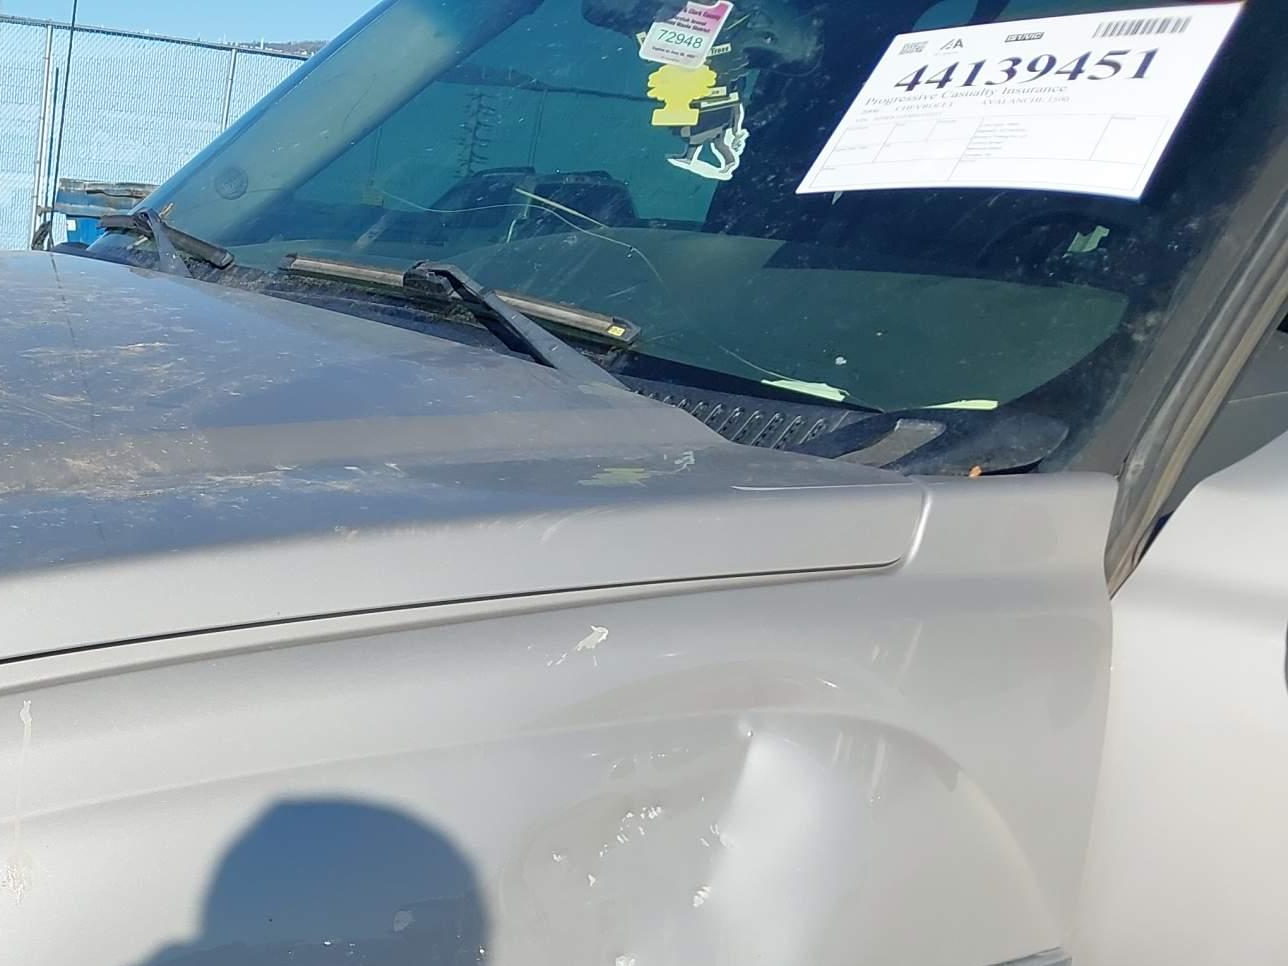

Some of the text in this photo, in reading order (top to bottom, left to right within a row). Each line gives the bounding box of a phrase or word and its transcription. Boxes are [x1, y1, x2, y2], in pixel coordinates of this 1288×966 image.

[657, 29, 704, 49] 72948
[893, 48, 1161, 92] 44139451
[865, 85, 1068, 106] Progressive Casualty Insurance
